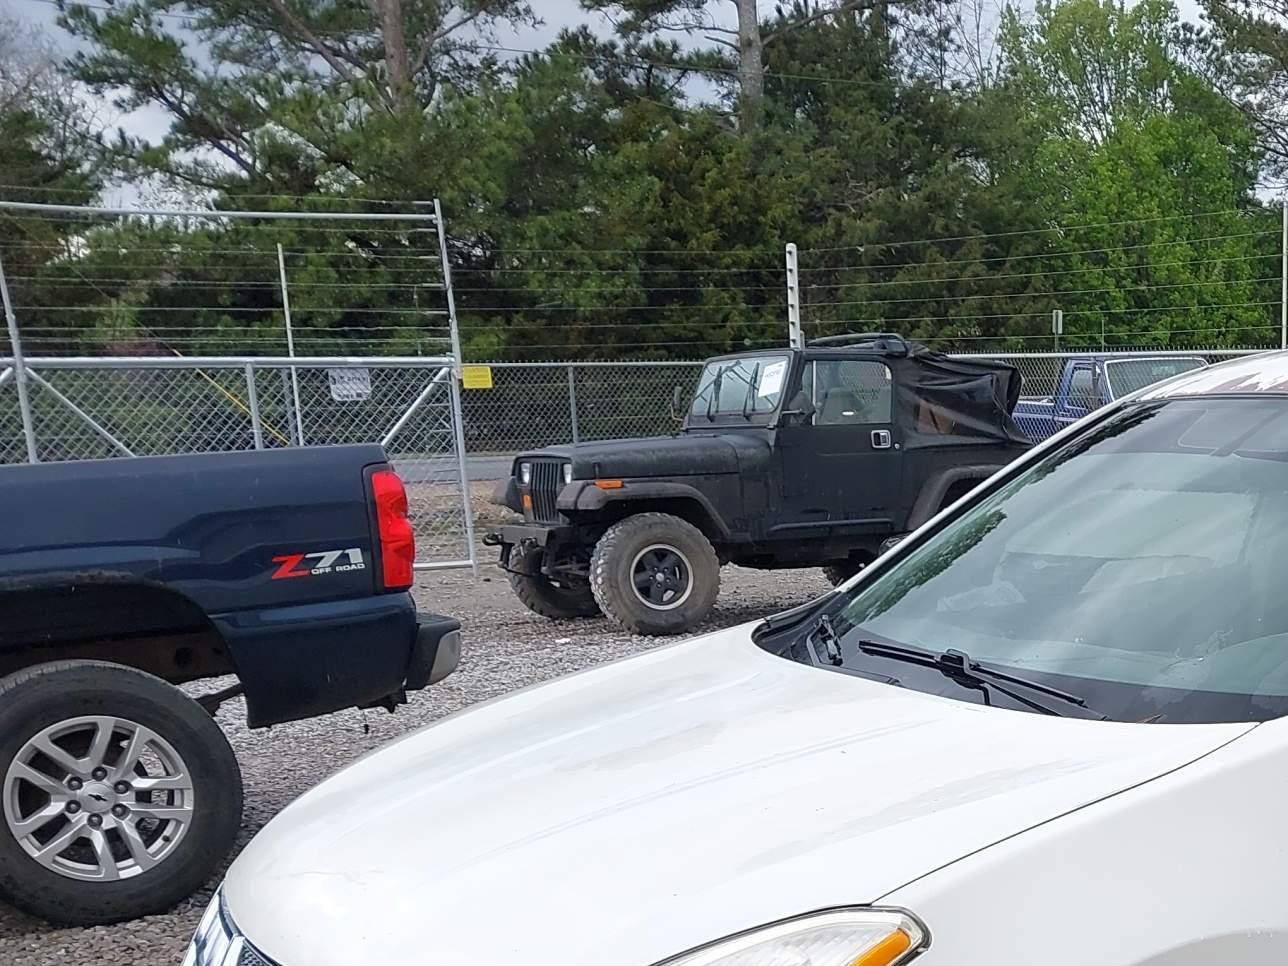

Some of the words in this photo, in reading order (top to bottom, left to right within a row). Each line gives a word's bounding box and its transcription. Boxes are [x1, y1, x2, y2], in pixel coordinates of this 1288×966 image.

[271, 547, 364, 580] Z71
[311, 567, 332, 575] OFF
[335, 563, 365, 572] ROAD
